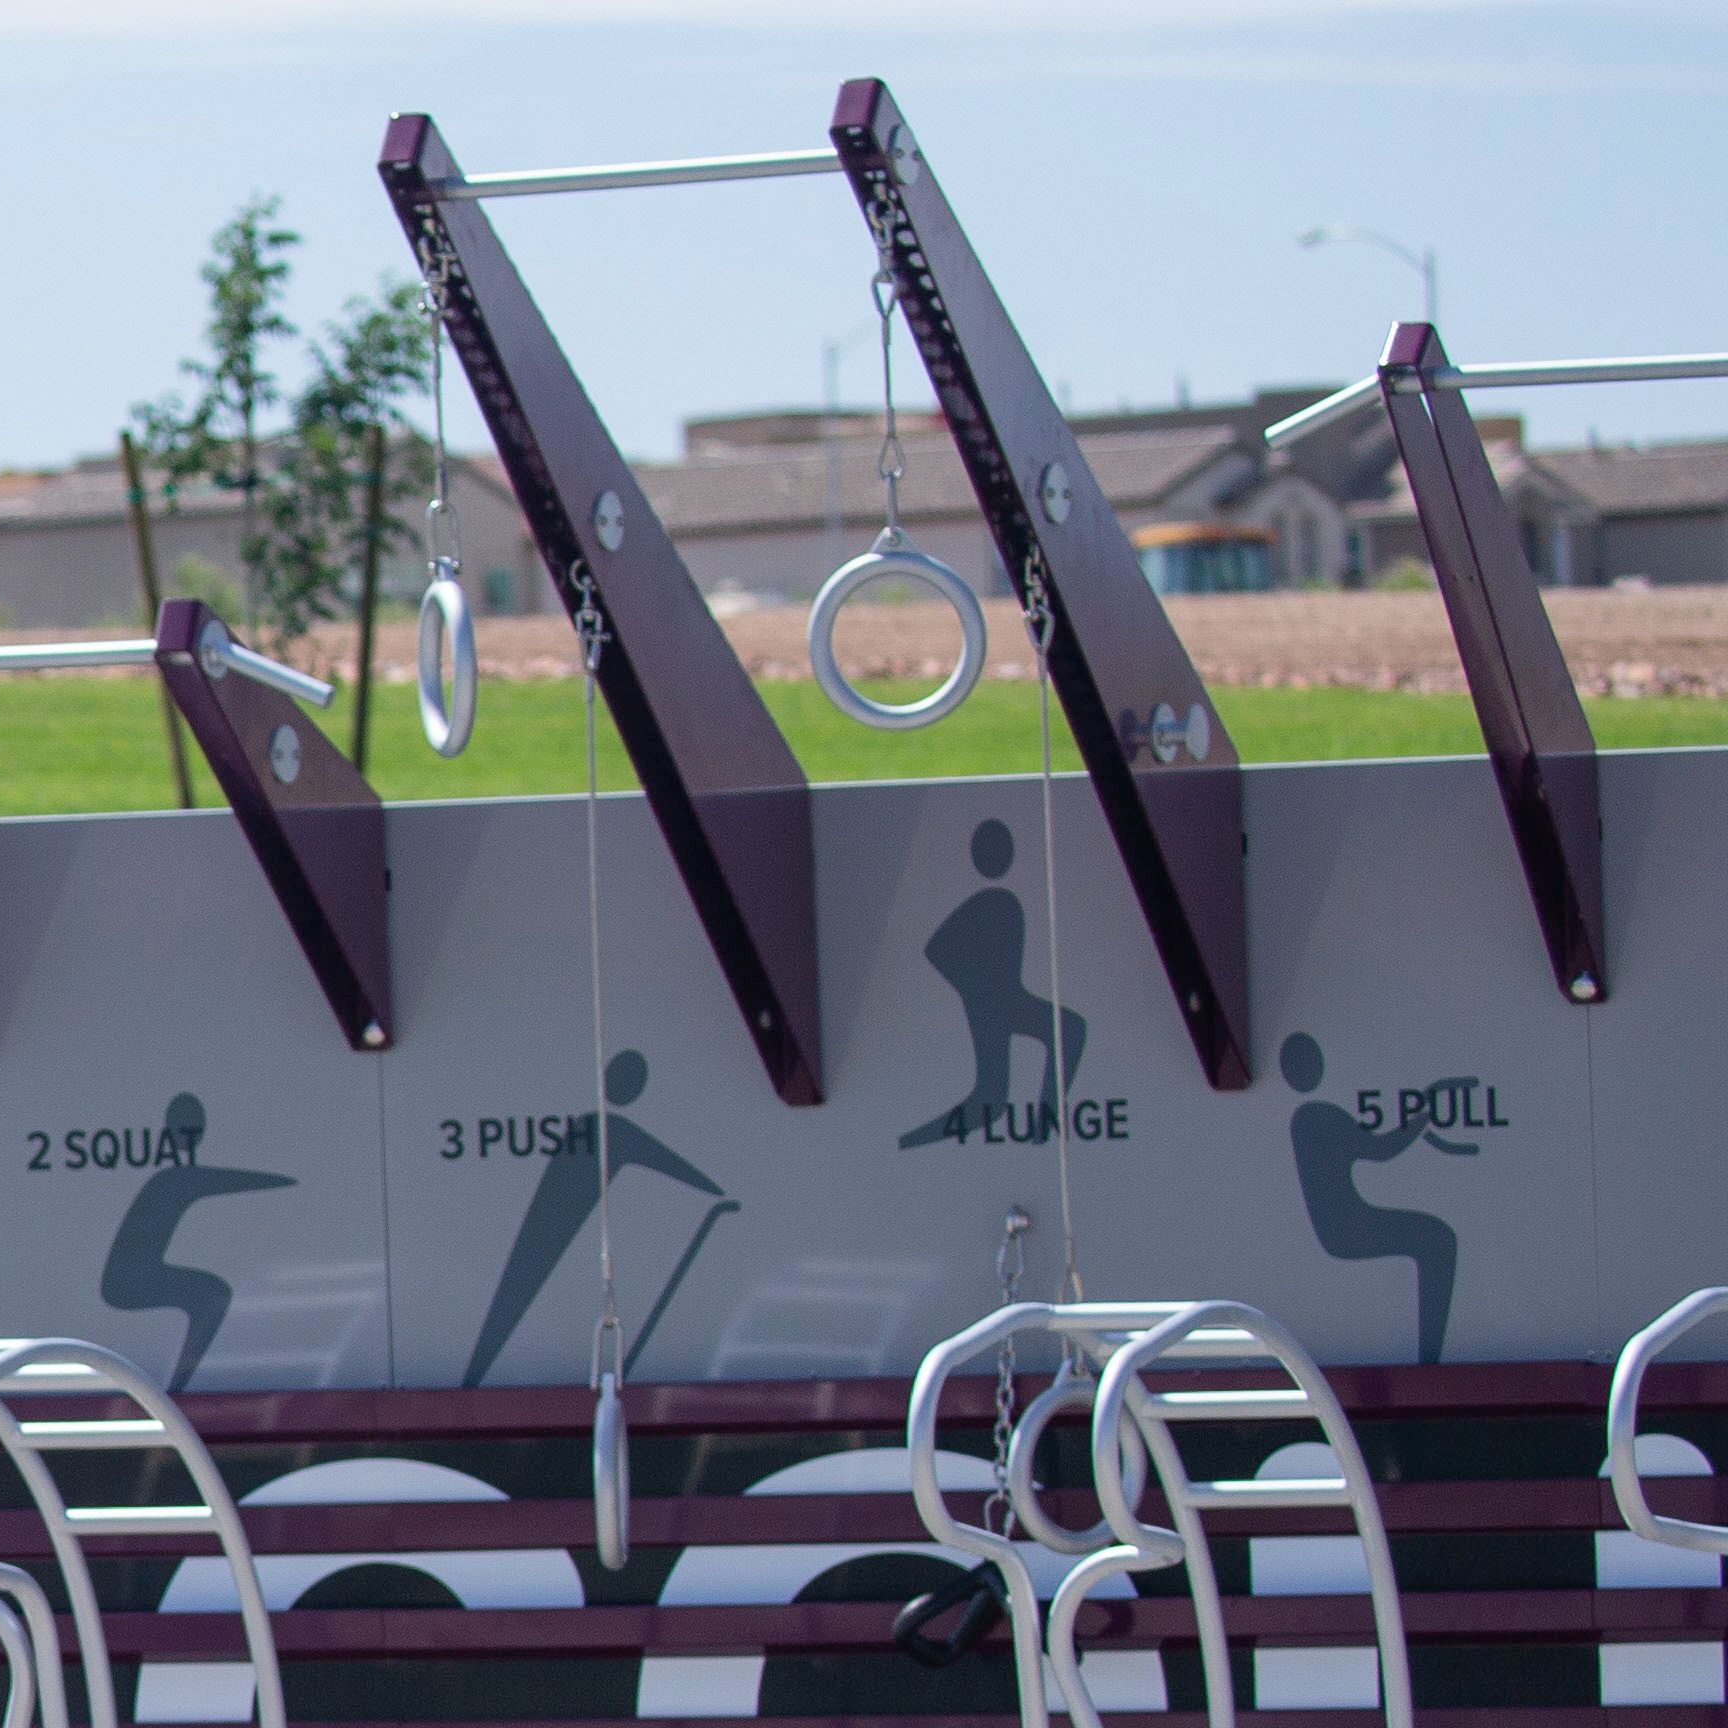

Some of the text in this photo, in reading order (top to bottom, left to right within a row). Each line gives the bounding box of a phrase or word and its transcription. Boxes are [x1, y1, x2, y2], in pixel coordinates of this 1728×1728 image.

[944, 1098, 1129, 1144] 4 LUNGE
[1357, 1085, 1509, 1130] 5 PULL
[26, 1125, 204, 1172] 2 SQUAT
[439, 1113, 597, 1160] 3 PUSH
